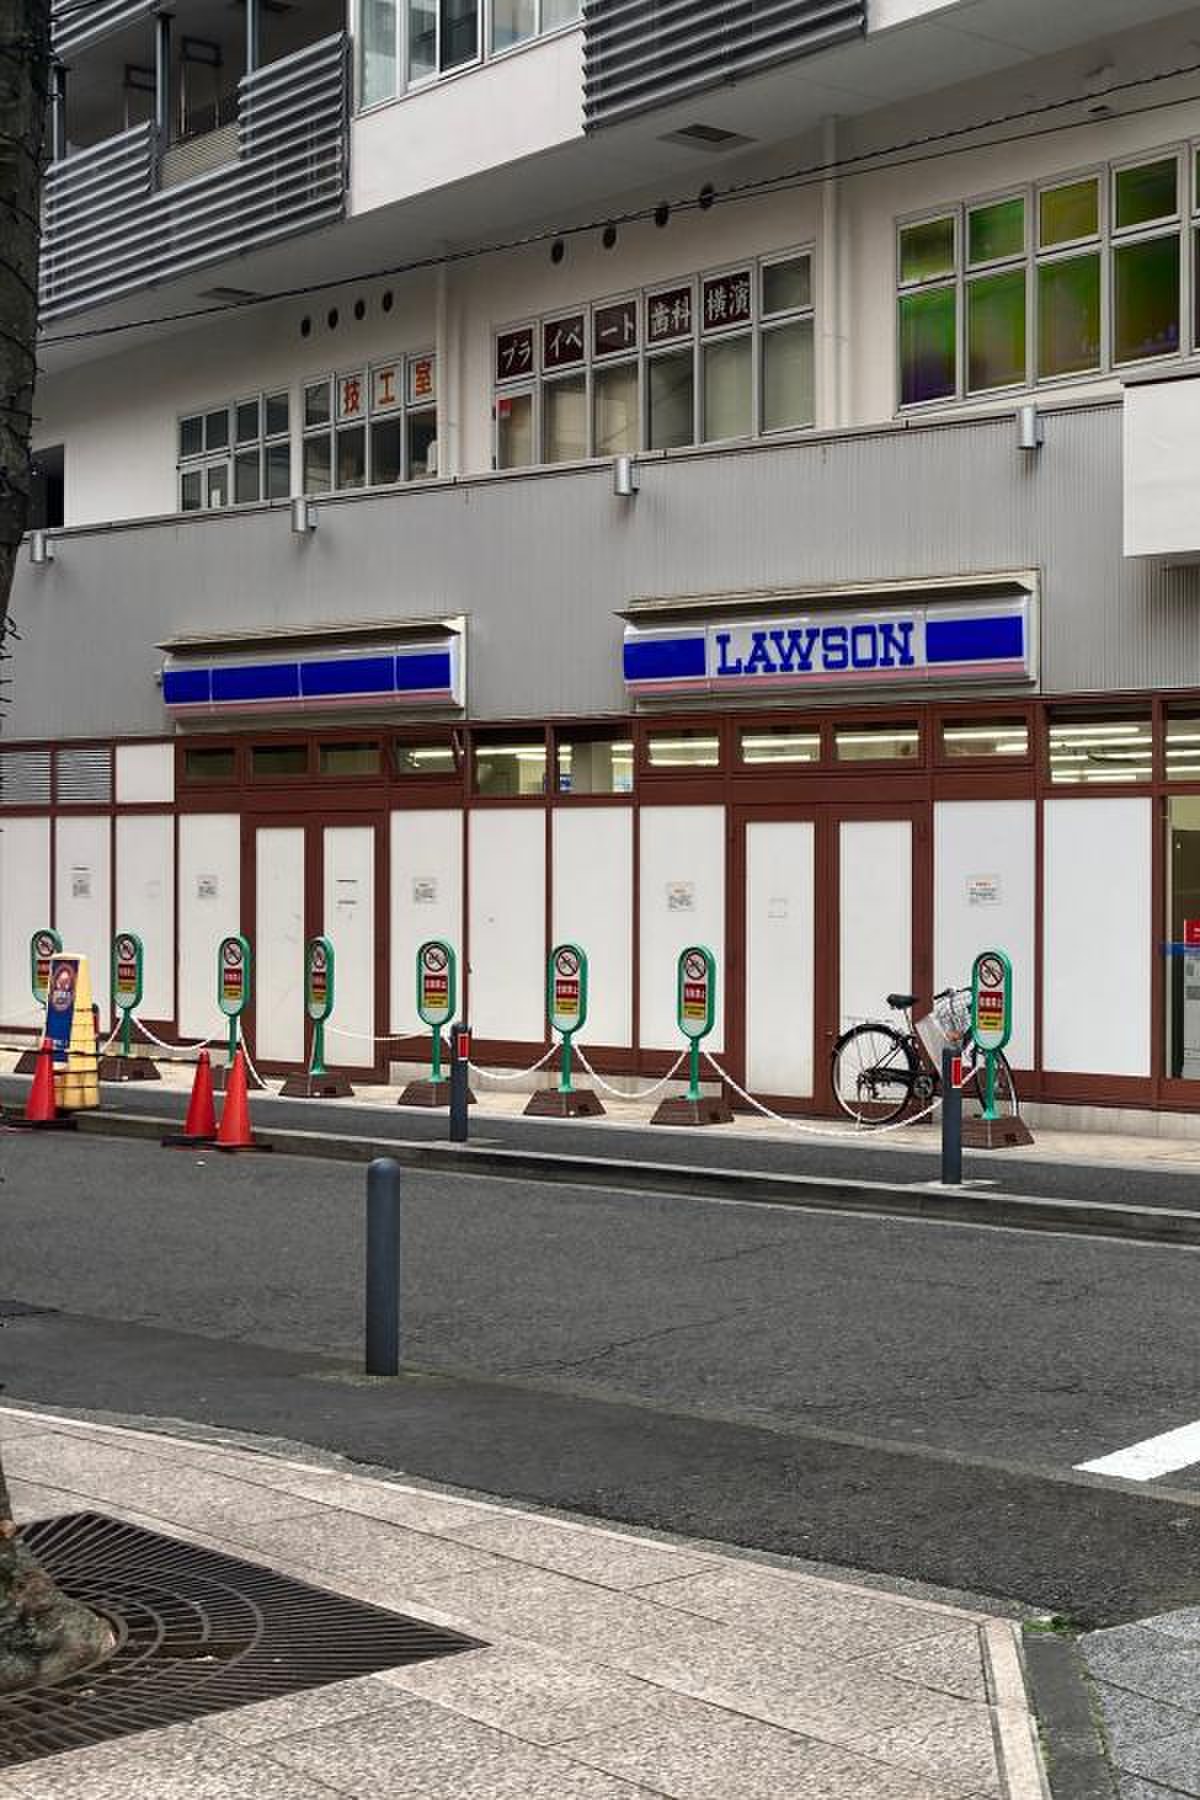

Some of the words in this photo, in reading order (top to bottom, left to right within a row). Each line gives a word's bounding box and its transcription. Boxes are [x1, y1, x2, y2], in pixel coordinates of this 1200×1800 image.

[343, 361, 433, 415] 技工室
[715, 621, 915, 676] LAWSON
